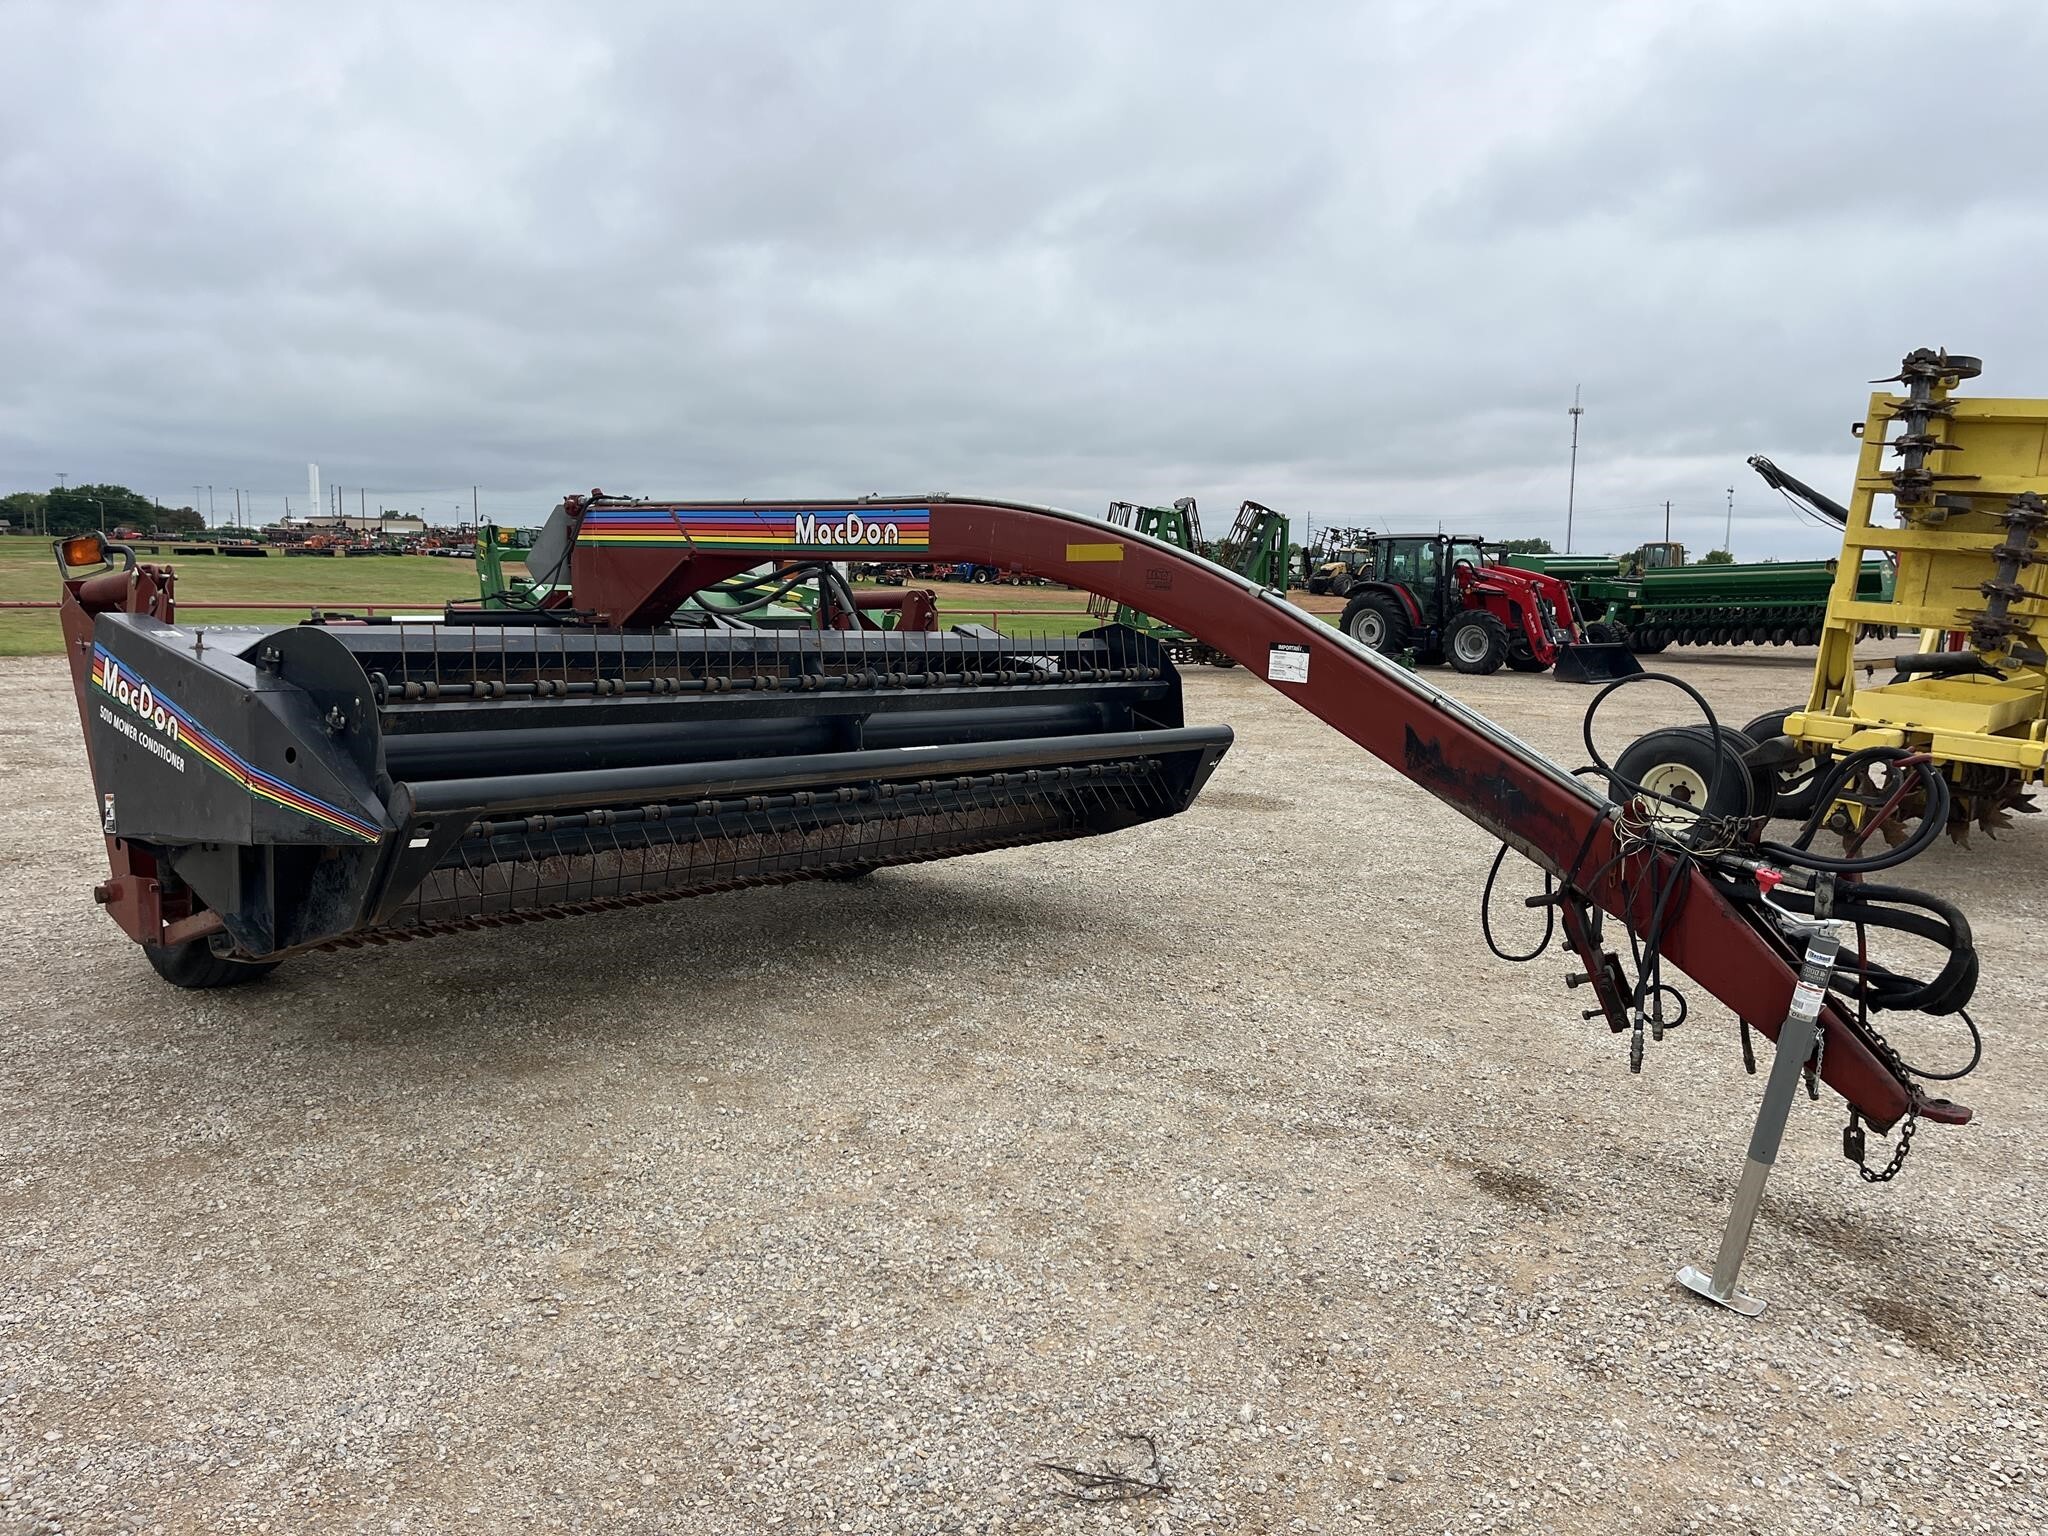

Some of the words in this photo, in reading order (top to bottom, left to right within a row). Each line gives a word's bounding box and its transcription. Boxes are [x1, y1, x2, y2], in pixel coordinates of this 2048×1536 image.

[795, 513, 899, 545] MacDon
[103, 656, 179, 741] MacDon
[113, 714, 138, 742] MOWER
[138, 731, 185, 773] CONDITIONER
